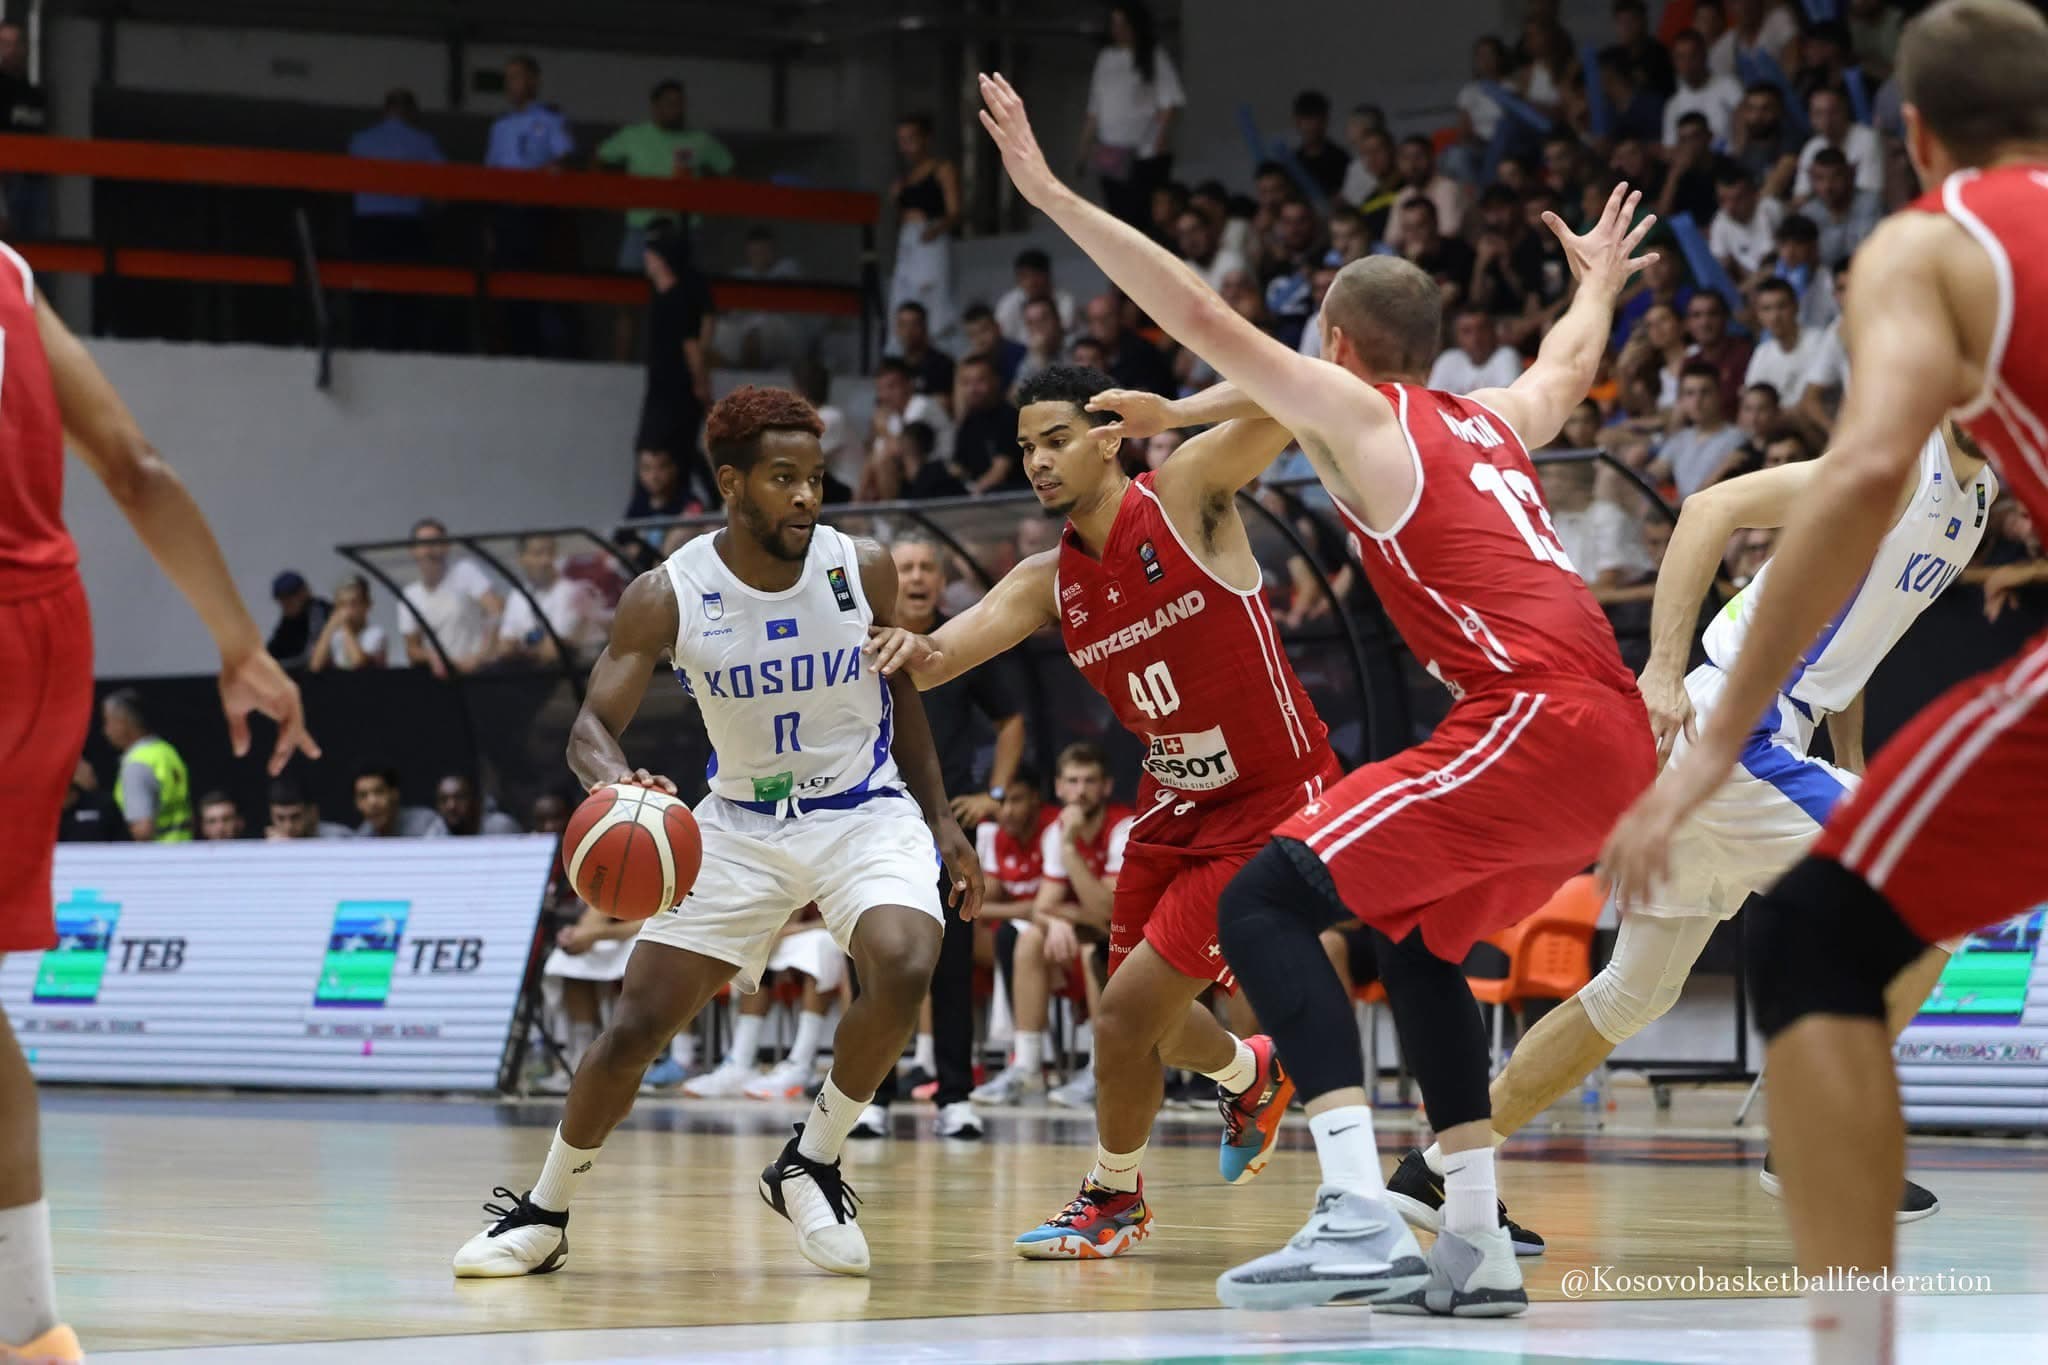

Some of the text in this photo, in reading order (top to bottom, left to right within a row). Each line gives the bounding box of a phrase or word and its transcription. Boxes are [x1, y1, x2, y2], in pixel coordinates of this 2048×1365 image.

[1469, 462, 1578, 574] 13
[1069, 590, 1206, 668] WITZERLAND
[704, 645, 861, 698] KOSOVA
[1127, 660, 1181, 719] 40
[119, 937, 188, 974] TEB
[409, 937, 485, 974] TEB
